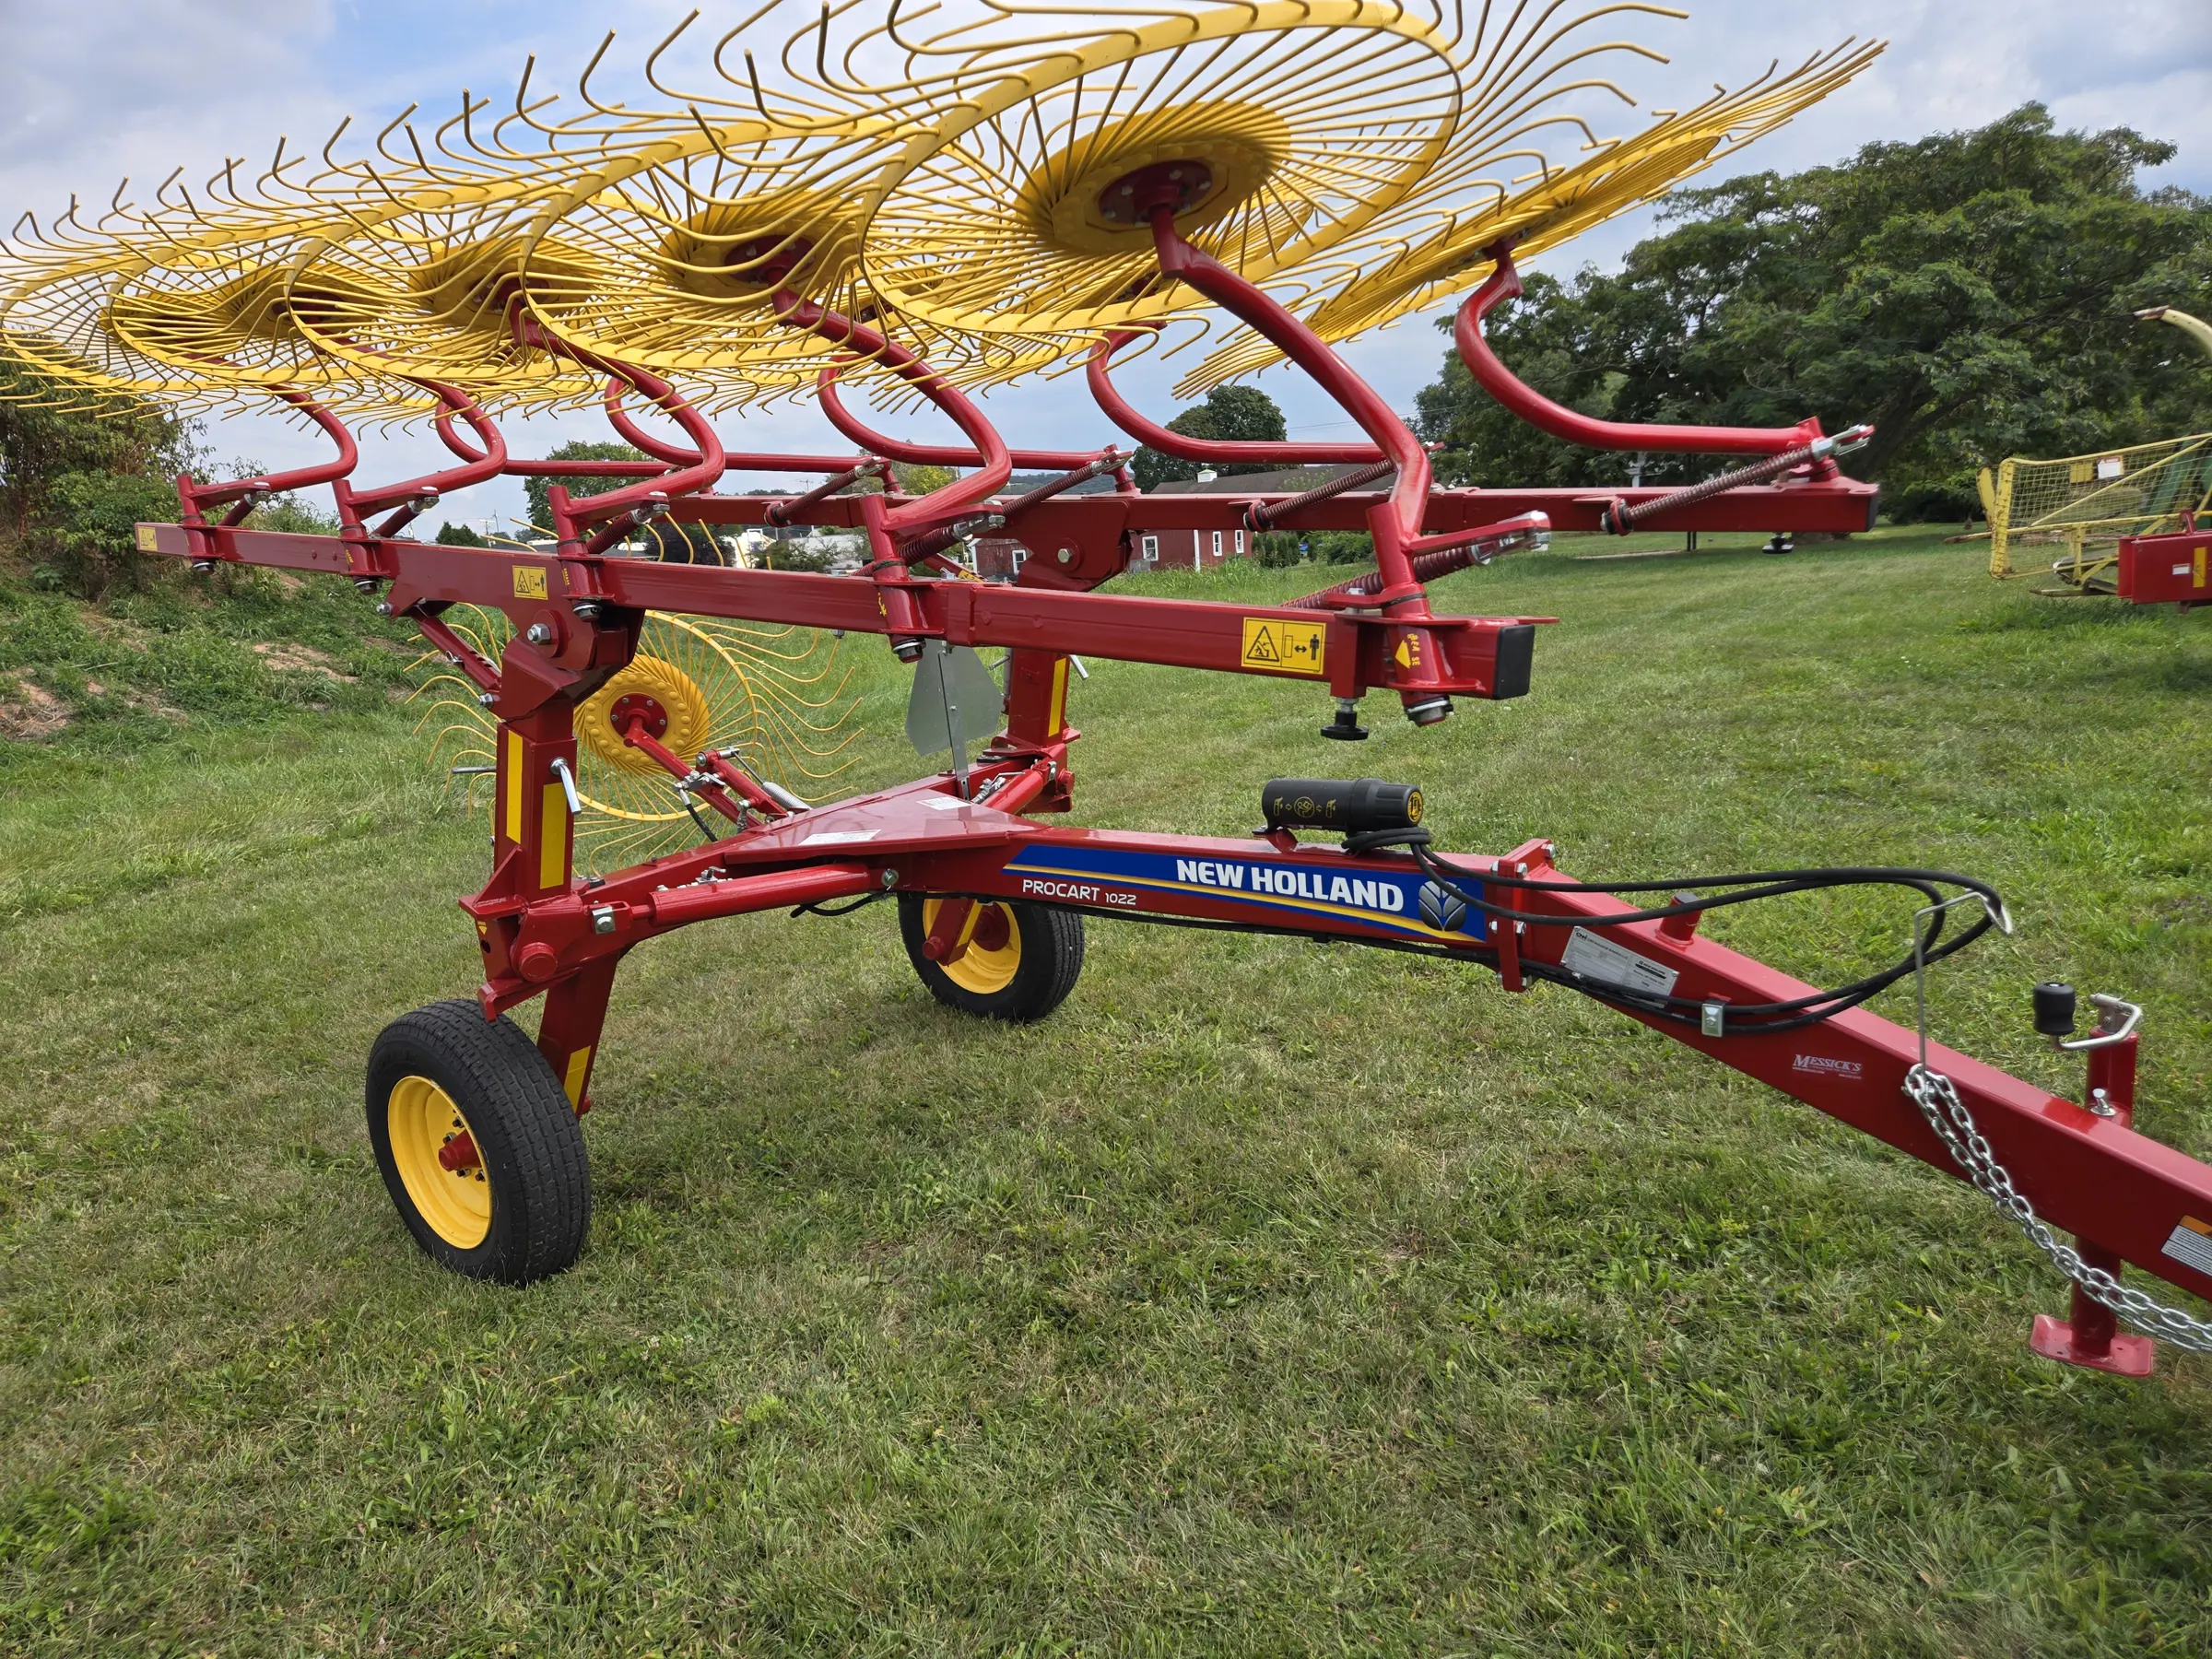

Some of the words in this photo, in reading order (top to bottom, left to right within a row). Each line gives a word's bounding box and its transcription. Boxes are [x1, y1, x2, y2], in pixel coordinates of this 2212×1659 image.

[1022, 878, 1100, 901] PROCART
[1105, 892, 1136, 905] 1022
[1176, 859, 1244, 888] NEW
[1251, 866, 1404, 912] HOLLAND
[1793, 1053, 1862, 1072] MESSICK'S
